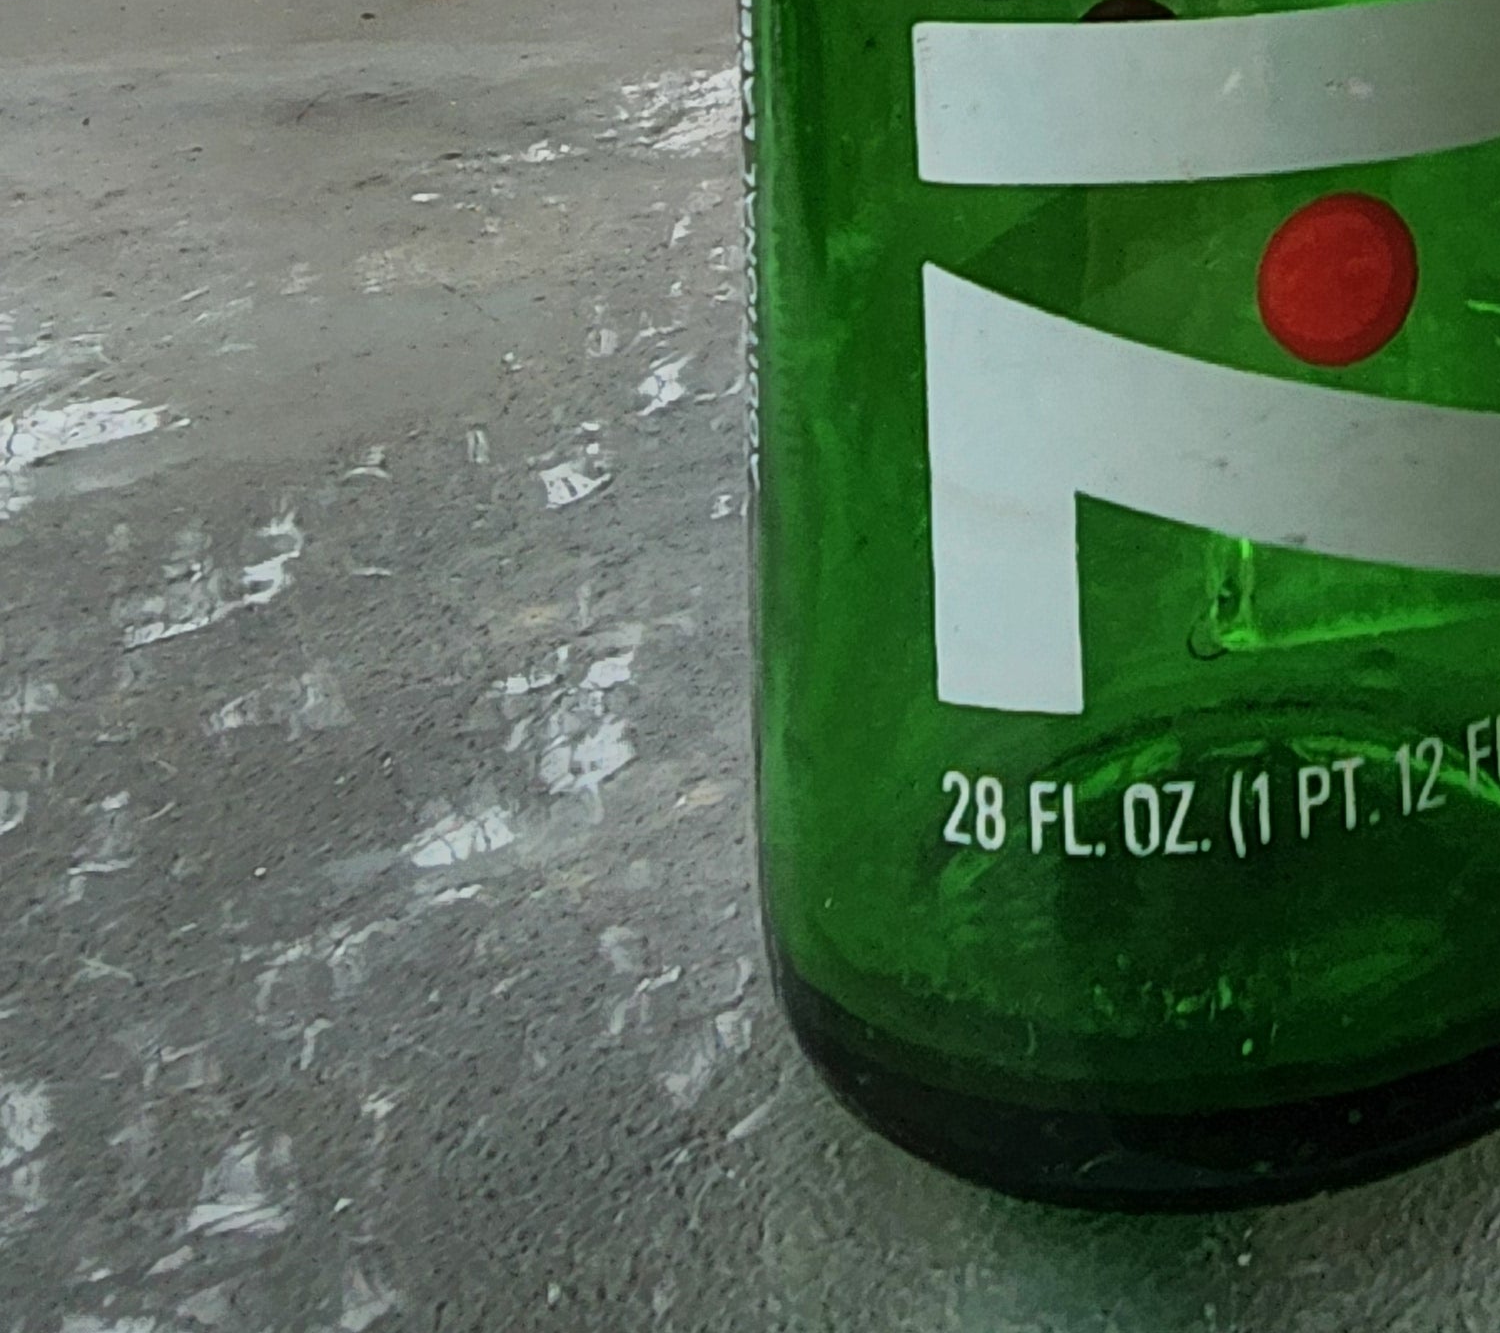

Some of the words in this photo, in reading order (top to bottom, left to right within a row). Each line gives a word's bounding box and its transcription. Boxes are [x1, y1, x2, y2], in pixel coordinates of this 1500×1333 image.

[941, 769, 1007, 851] 28
[1029, 779, 1107, 856] FL.
[1122, 780, 1213, 858] OZ.
[1228, 768, 1271, 859] (1
[1298, 756, 1381, 839] PT.
[1395, 736, 1447, 816] 12
